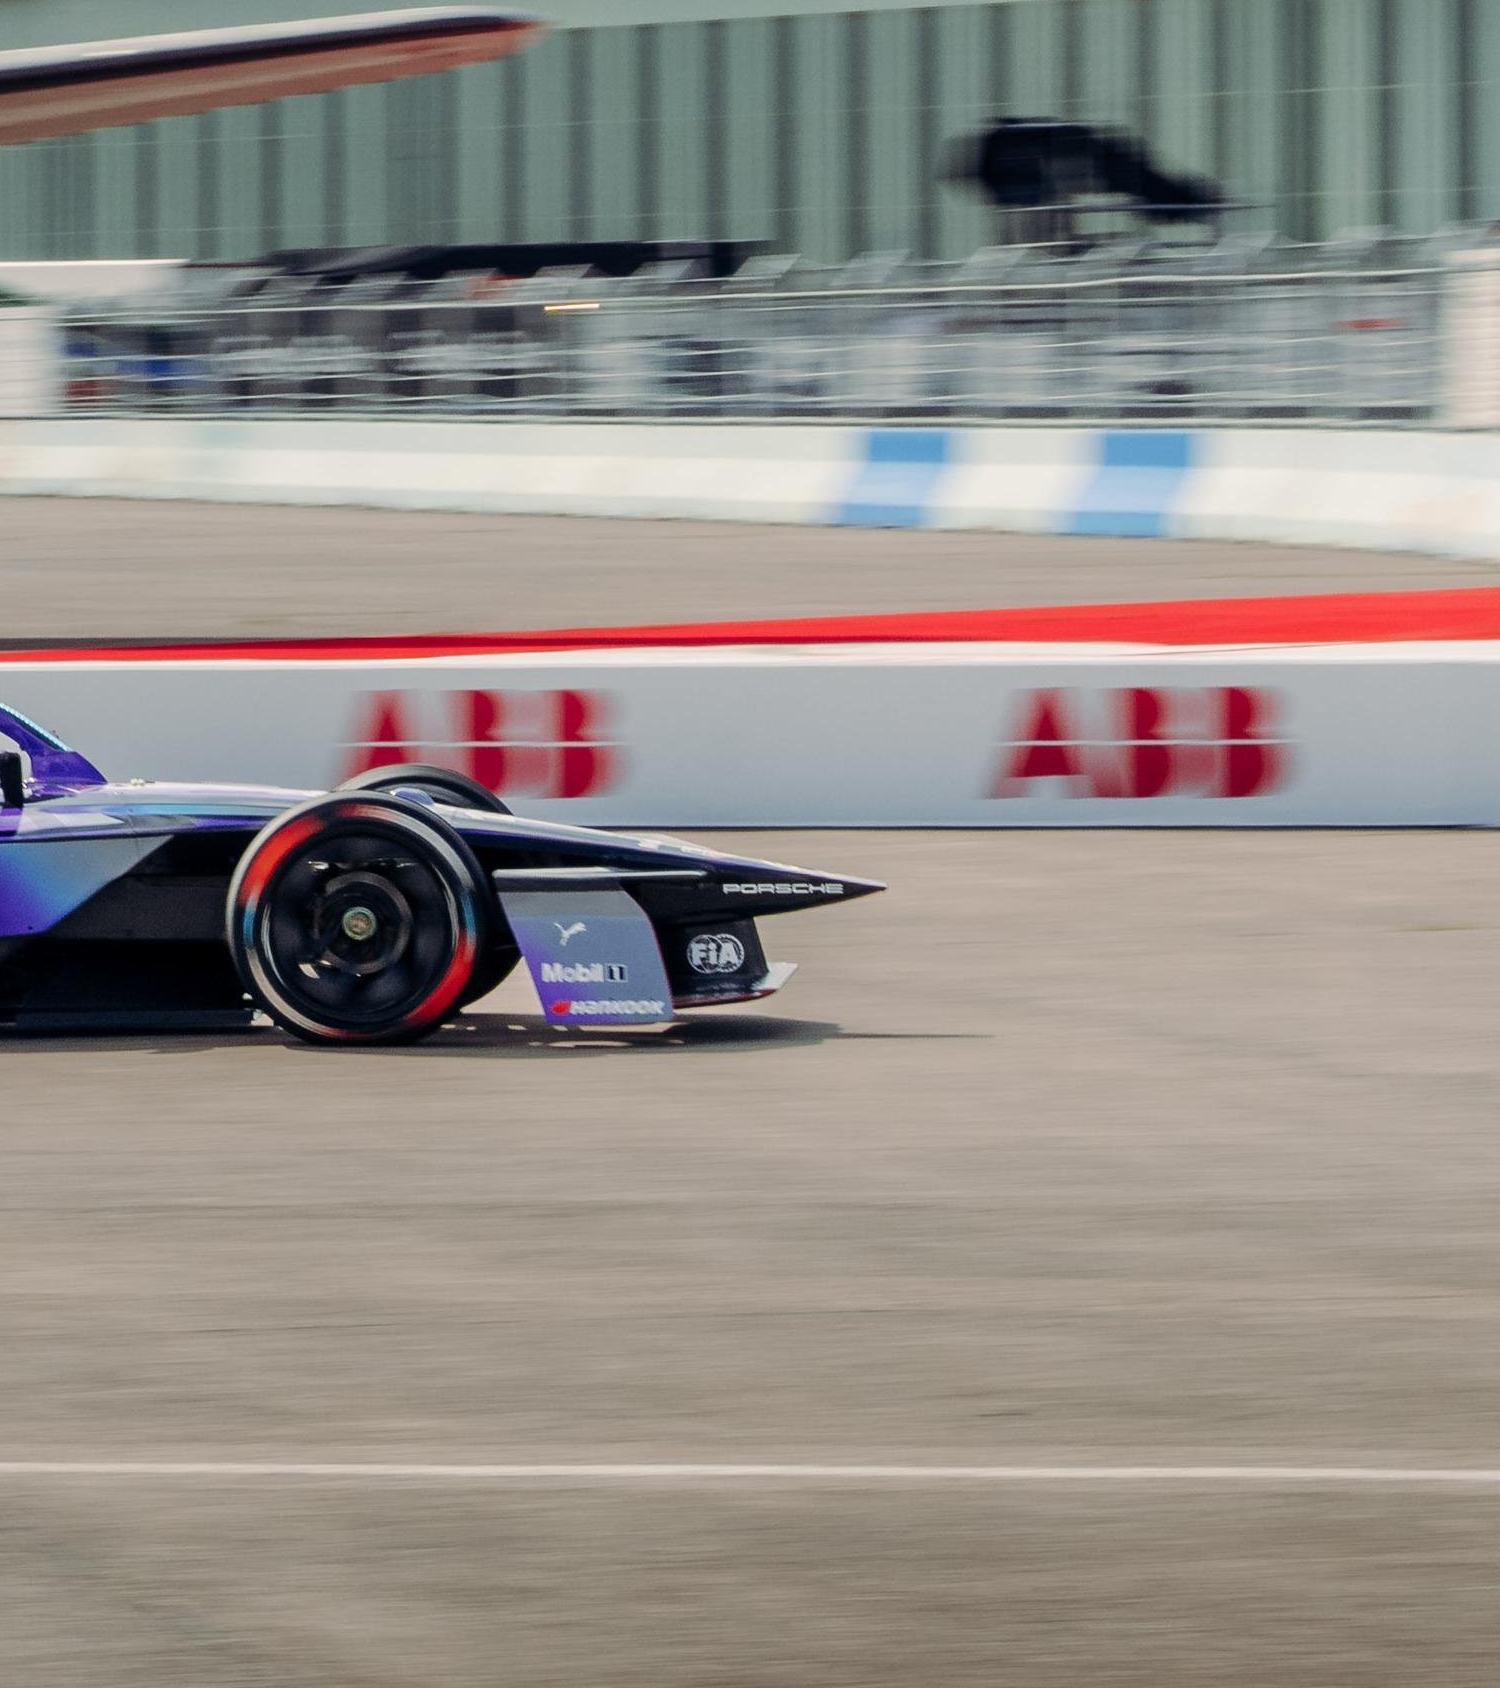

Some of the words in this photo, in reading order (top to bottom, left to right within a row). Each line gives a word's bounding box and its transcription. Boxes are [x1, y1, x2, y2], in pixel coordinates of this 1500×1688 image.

[332, 690, 630, 799] ABB
[980, 686, 1304, 799] ABB
[722, 883, 844, 895] PORSCHE
[540, 962, 604, 983] Mobil
